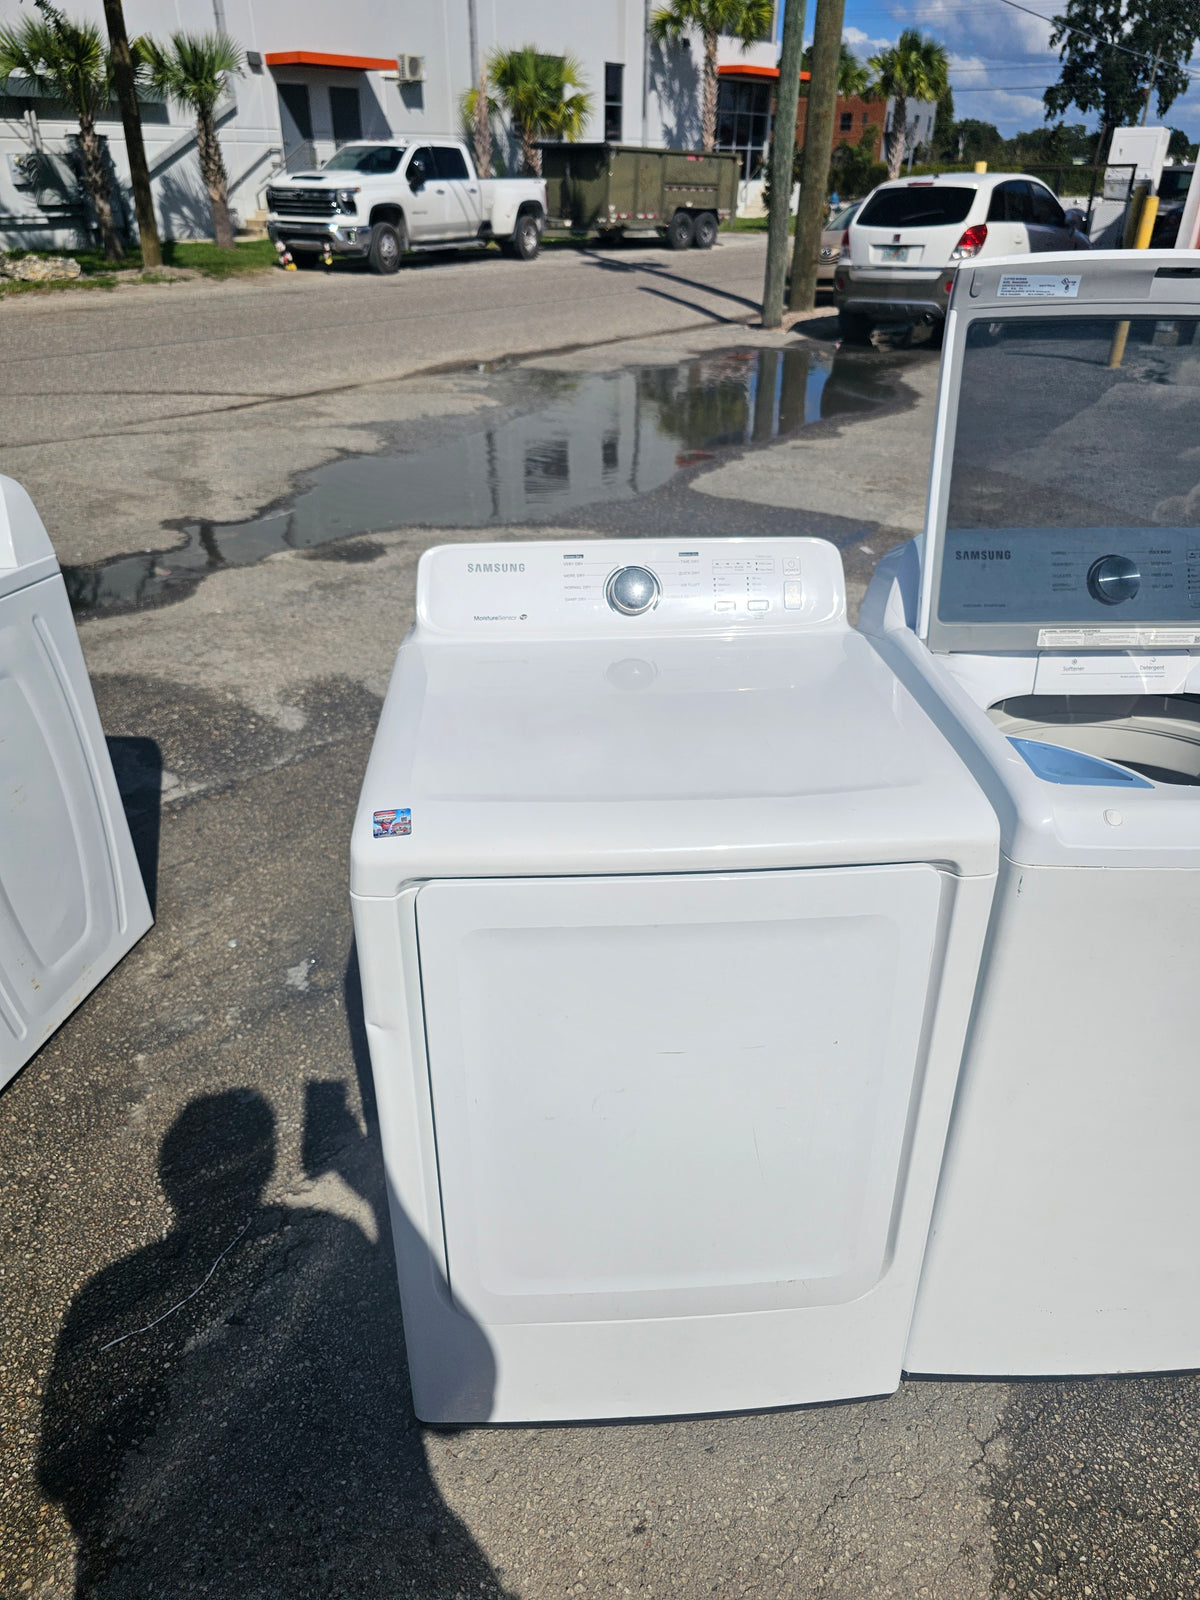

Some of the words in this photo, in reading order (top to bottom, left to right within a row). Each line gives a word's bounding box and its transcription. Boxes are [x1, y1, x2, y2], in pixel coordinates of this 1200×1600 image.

[955, 550, 1012, 561] SAMSUNG
[467, 563, 525, 573] SAMSUNG
[1139, 664, 1165, 672] Detergent
